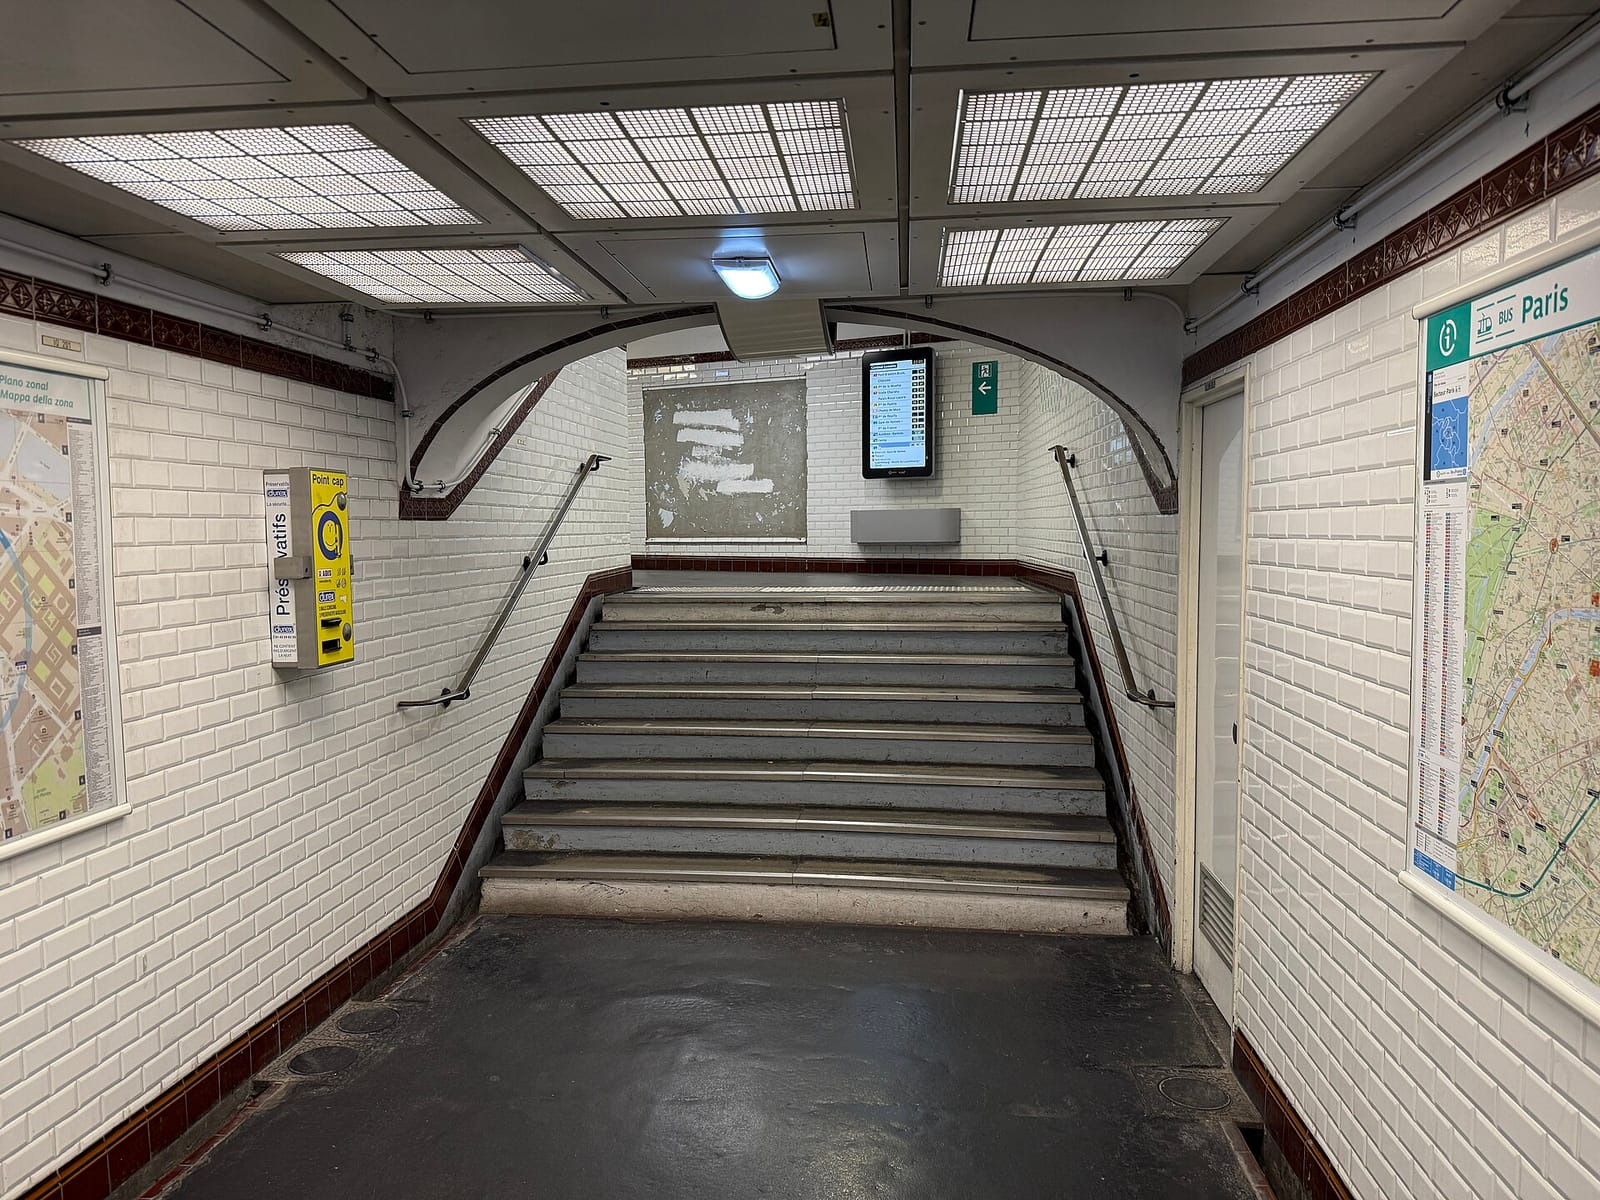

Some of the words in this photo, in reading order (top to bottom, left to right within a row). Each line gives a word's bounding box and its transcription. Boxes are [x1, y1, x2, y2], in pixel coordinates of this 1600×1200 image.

[1498, 307, 1514, 325] BUS
[1522, 282, 1569, 324] Paris
[25, 380, 49, 391] zonal
[0, 389, 31, 404] Mappa
[32, 393, 53, 405] della
[54, 398, 74, 408] zona
[312, 473, 330, 485] Point
[332, 478, 344, 488] cap
